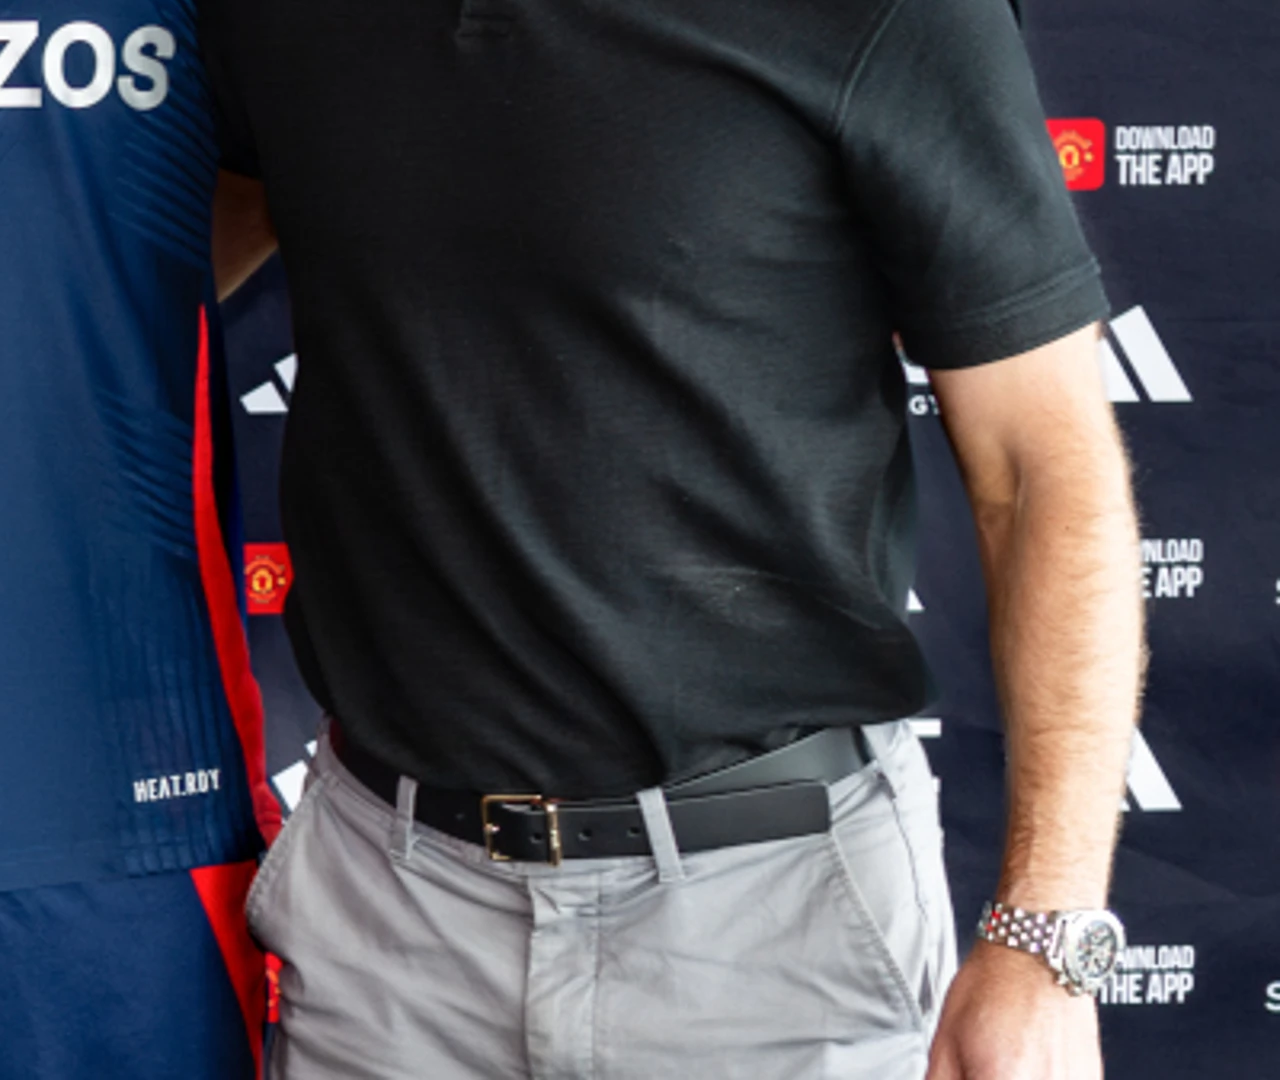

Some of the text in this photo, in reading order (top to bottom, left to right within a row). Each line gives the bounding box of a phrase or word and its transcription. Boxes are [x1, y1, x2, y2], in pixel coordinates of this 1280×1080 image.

[1115, 126, 1215, 151] DOWNLOAD
[1115, 152, 1214, 185] THE APP
[1141, 539, 1204, 563] NLOAD
[1155, 566, 1203, 597] APP
[134, 769, 219, 802] HEAT.RDY
[1146, 969, 1194, 1003] APP
